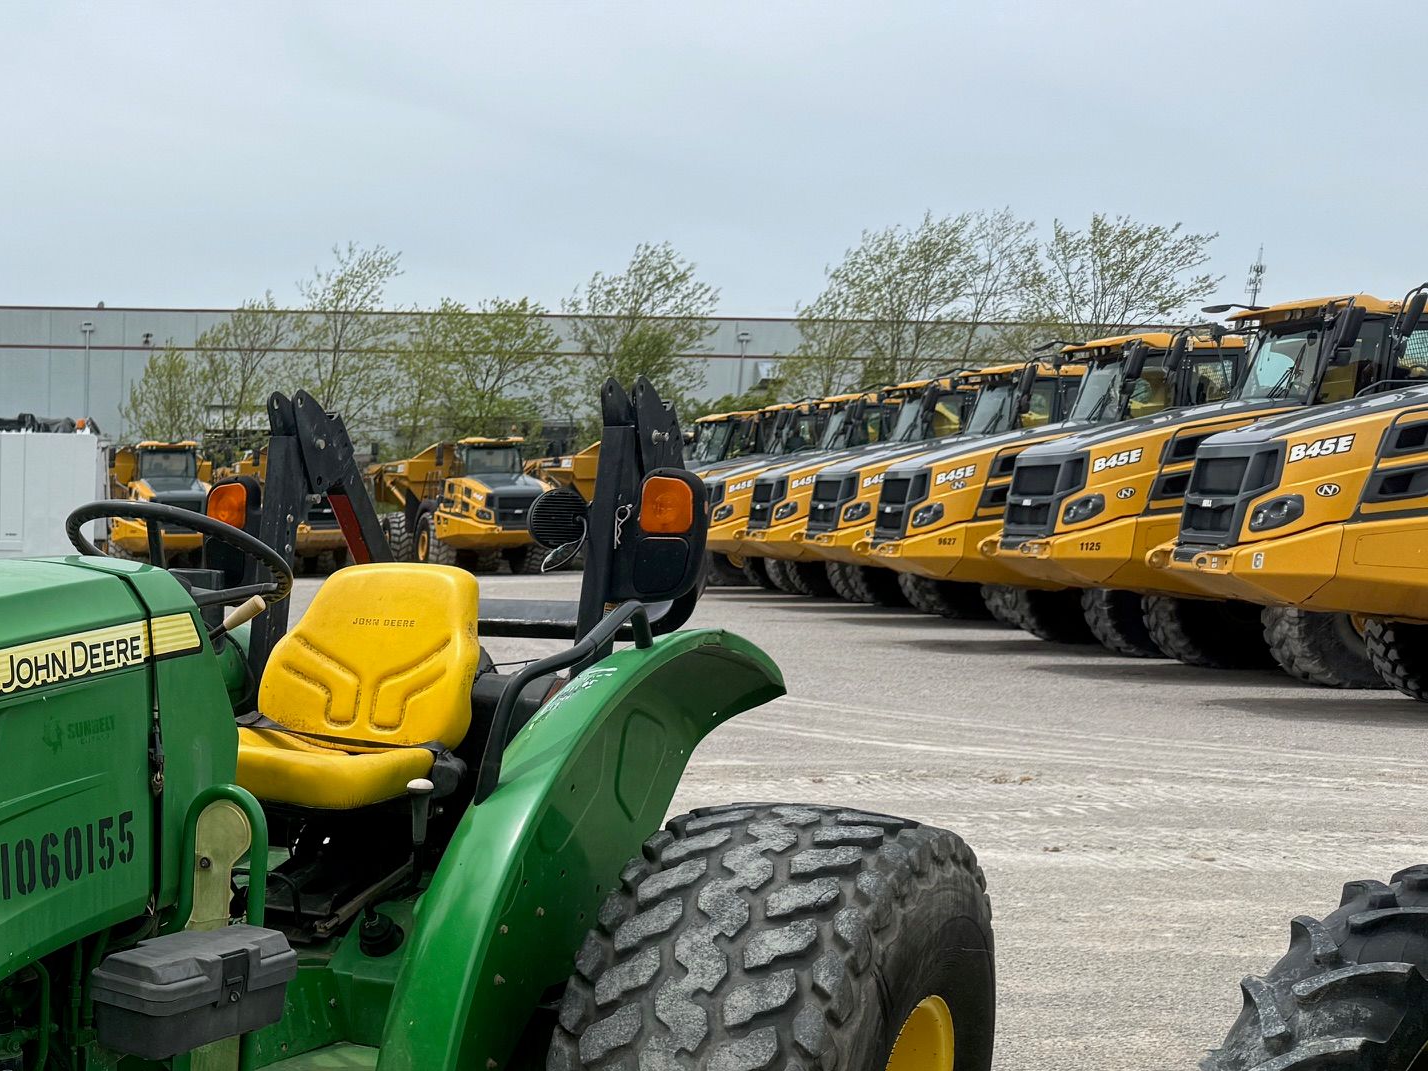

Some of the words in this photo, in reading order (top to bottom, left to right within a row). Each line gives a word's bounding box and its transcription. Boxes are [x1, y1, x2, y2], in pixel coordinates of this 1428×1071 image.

[1287, 433, 1356, 464] B45E
[1092, 447, 1144, 473] B45E
[728, 479, 754, 493] B45E
[862, 473, 885, 488] B45
[934, 464, 977, 486] B45E
[1079, 542, 1101, 551] 1125
[352, 617, 379, 626] JOHN
[383, 619, 416, 628] DEERE
[2, 651, 68, 690] JOHN
[71, 635, 143, 672] DEERE
[0, 810, 134, 900] 1060155
